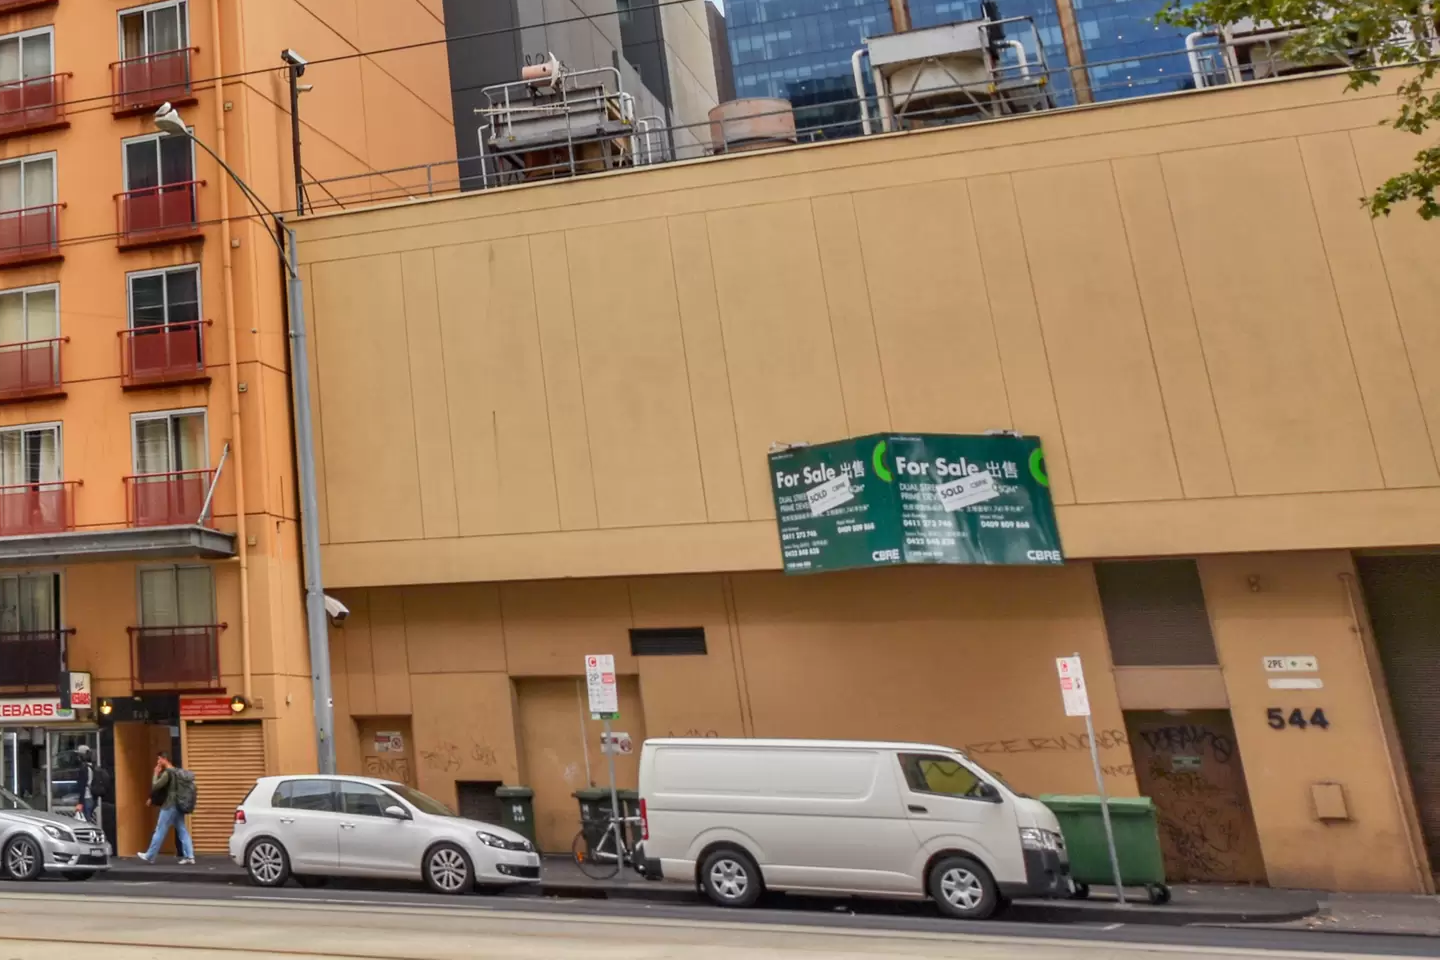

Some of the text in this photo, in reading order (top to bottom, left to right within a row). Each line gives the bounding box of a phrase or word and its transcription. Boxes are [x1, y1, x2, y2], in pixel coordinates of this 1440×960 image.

[895, 456, 980, 476] For Sale
[985, 460, 1018, 478] 出售
[775, 462, 836, 489] For Sale
[899, 483, 918, 491] DUAL
[941, 485, 964, 499] SOLD
[810, 489, 828, 504] SOLD
[872, 548, 900, 561] CBRE
[1026, 550, 1061, 561] CBRE
[1266, 707, 1330, 730] 544
